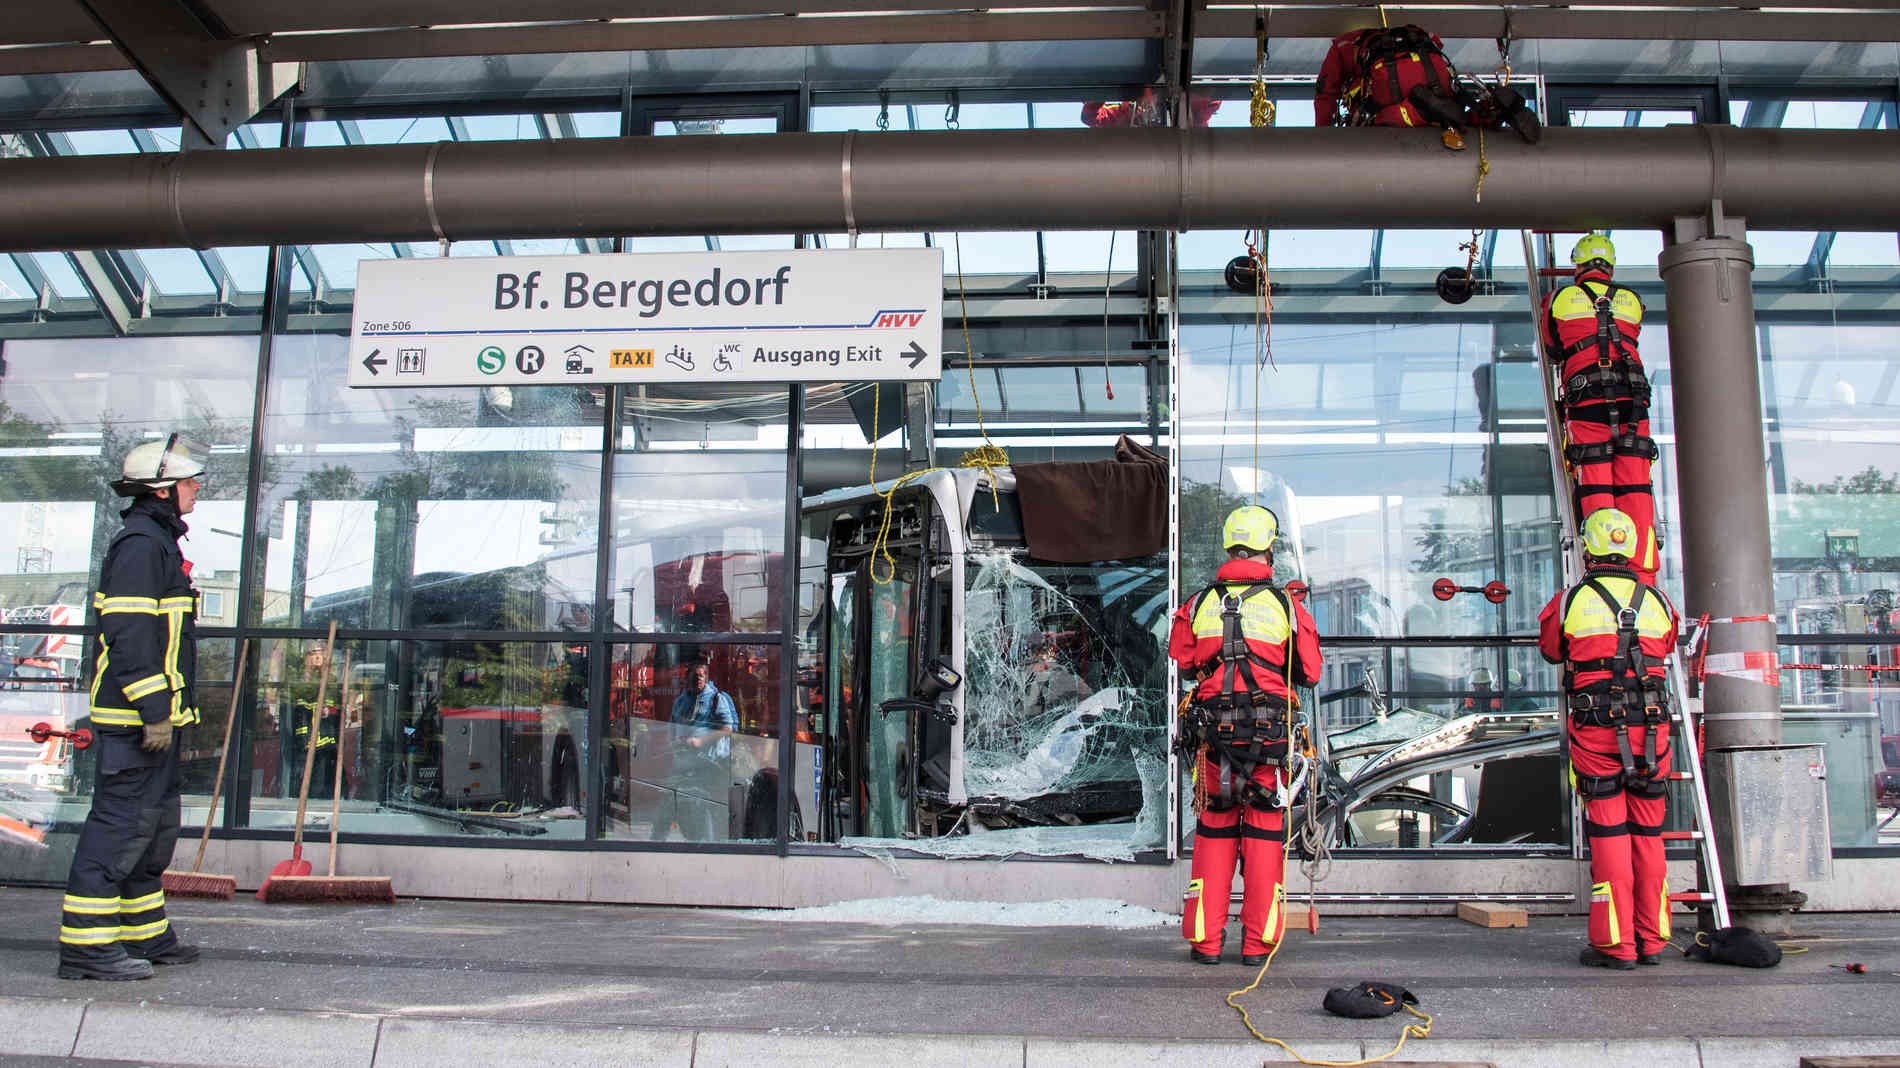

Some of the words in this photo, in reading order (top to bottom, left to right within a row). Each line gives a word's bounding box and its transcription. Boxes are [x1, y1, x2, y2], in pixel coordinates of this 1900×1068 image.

[494, 271, 549, 310] Bf.
[563, 266, 792, 318] Bergedorf
[363, 321, 390, 331] Zone
[391, 320, 412, 331] 506
[878, 314, 923, 328] HVV
[724, 344, 741, 353] WC
[613, 351, 652, 366] TAXI
[753, 347, 840, 367] Ausgang
[846, 345, 882, 362] Exit
